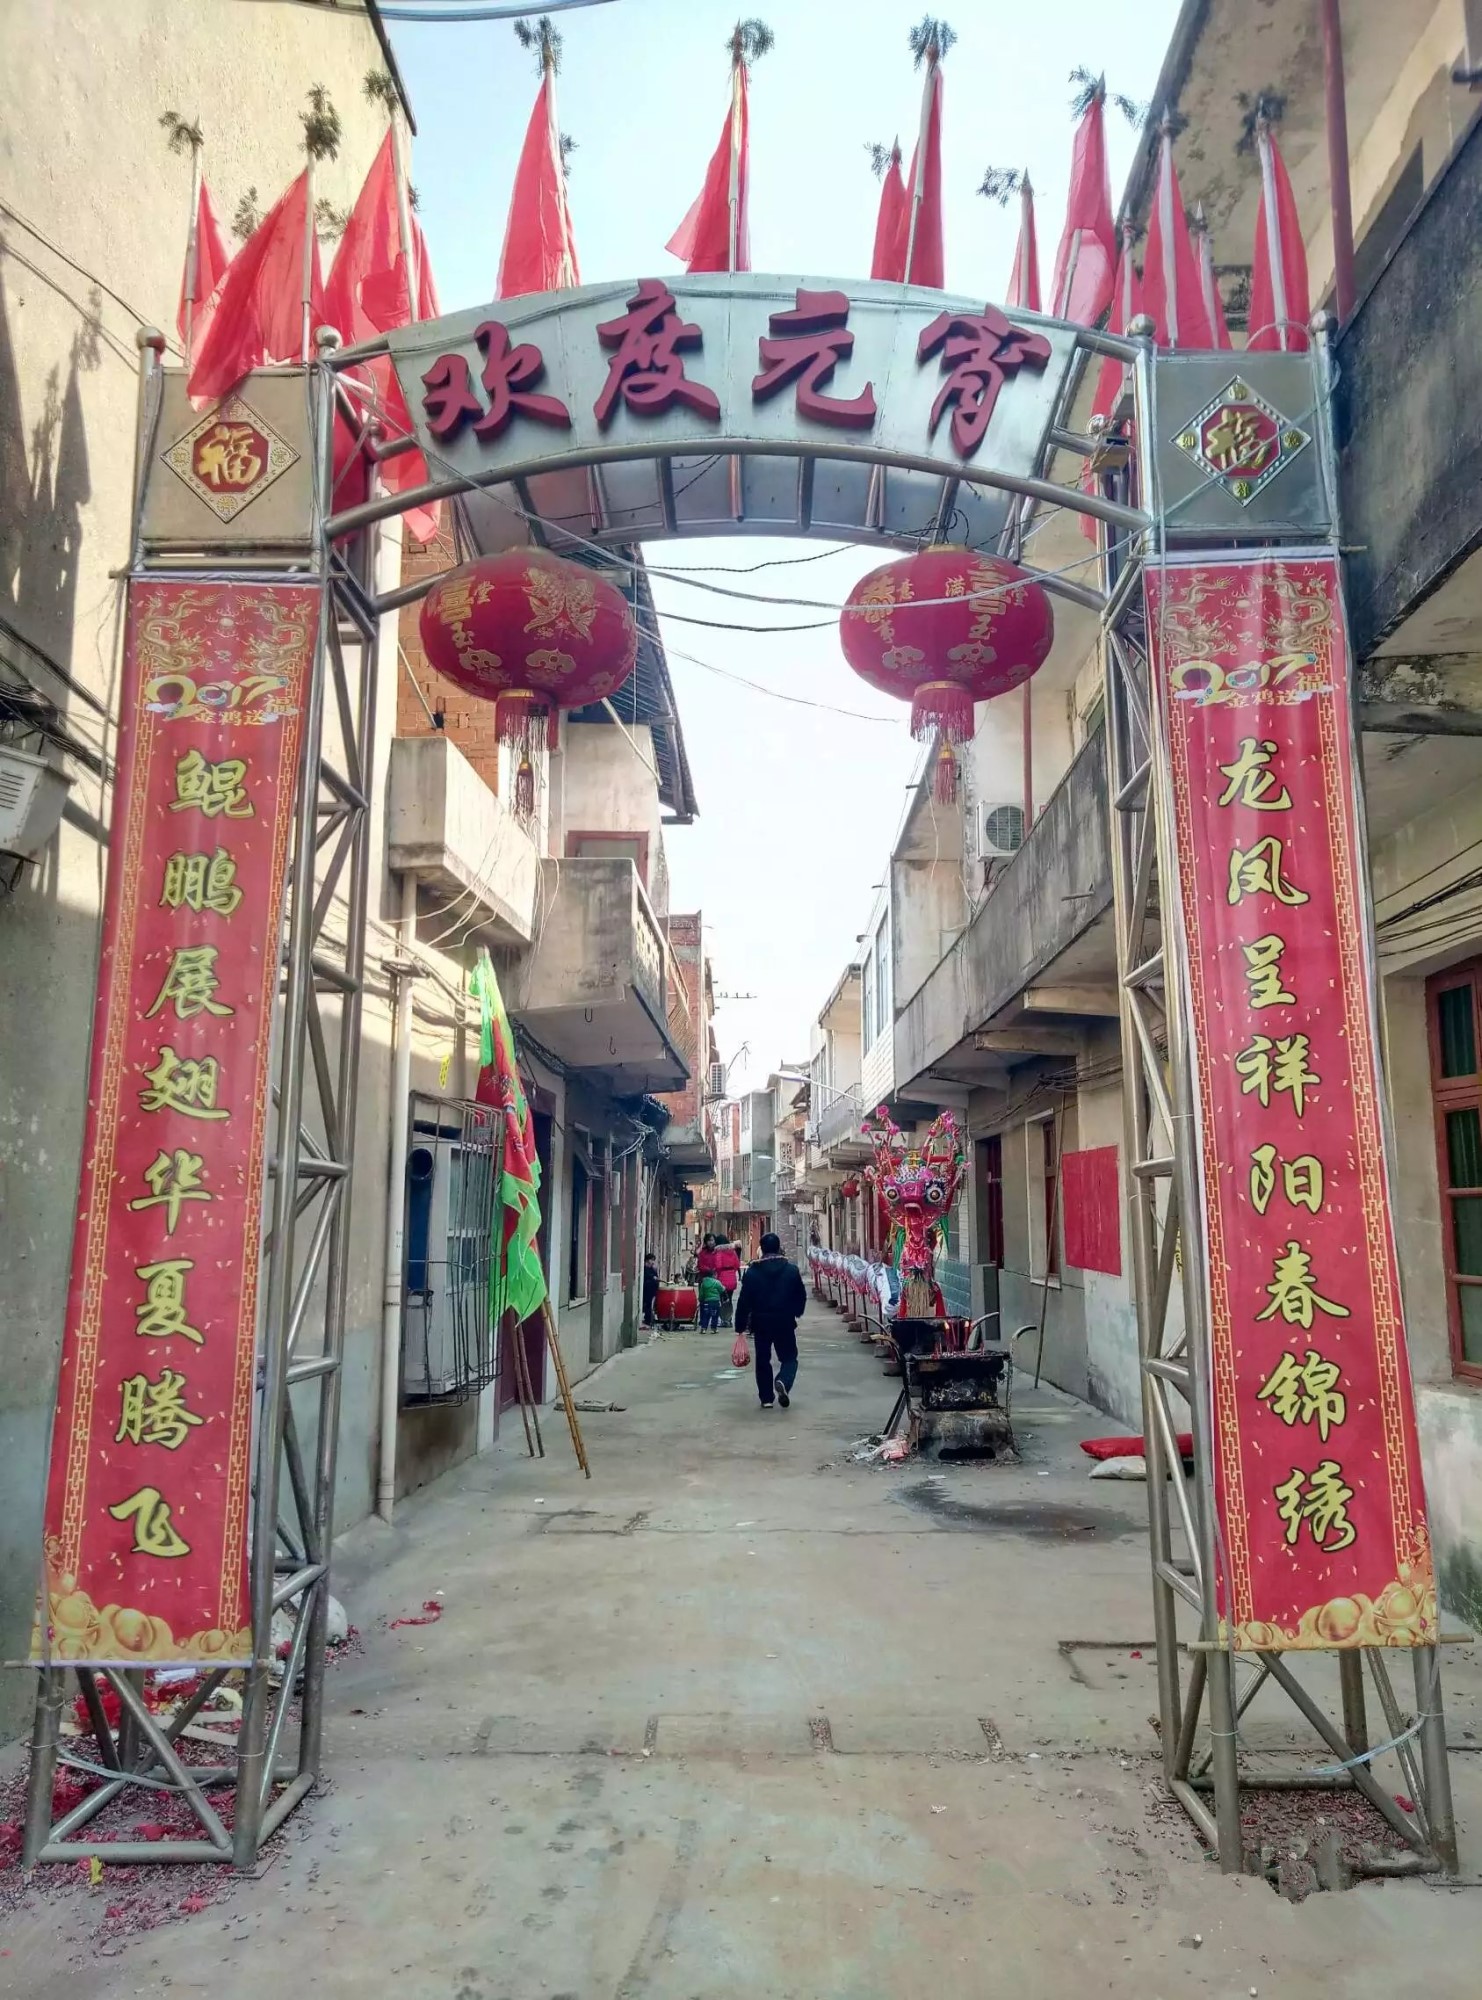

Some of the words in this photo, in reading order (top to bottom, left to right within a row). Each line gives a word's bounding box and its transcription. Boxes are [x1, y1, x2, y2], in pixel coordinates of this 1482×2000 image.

[198, 424, 261, 485] 福
[421, 278, 1051, 457] 欢度元宵
[109, 748, 256, 1559] 鲲鹏展翅华夏腾飞
[1217, 737, 1358, 1553] 龙凤呈祥阳春锦绣
